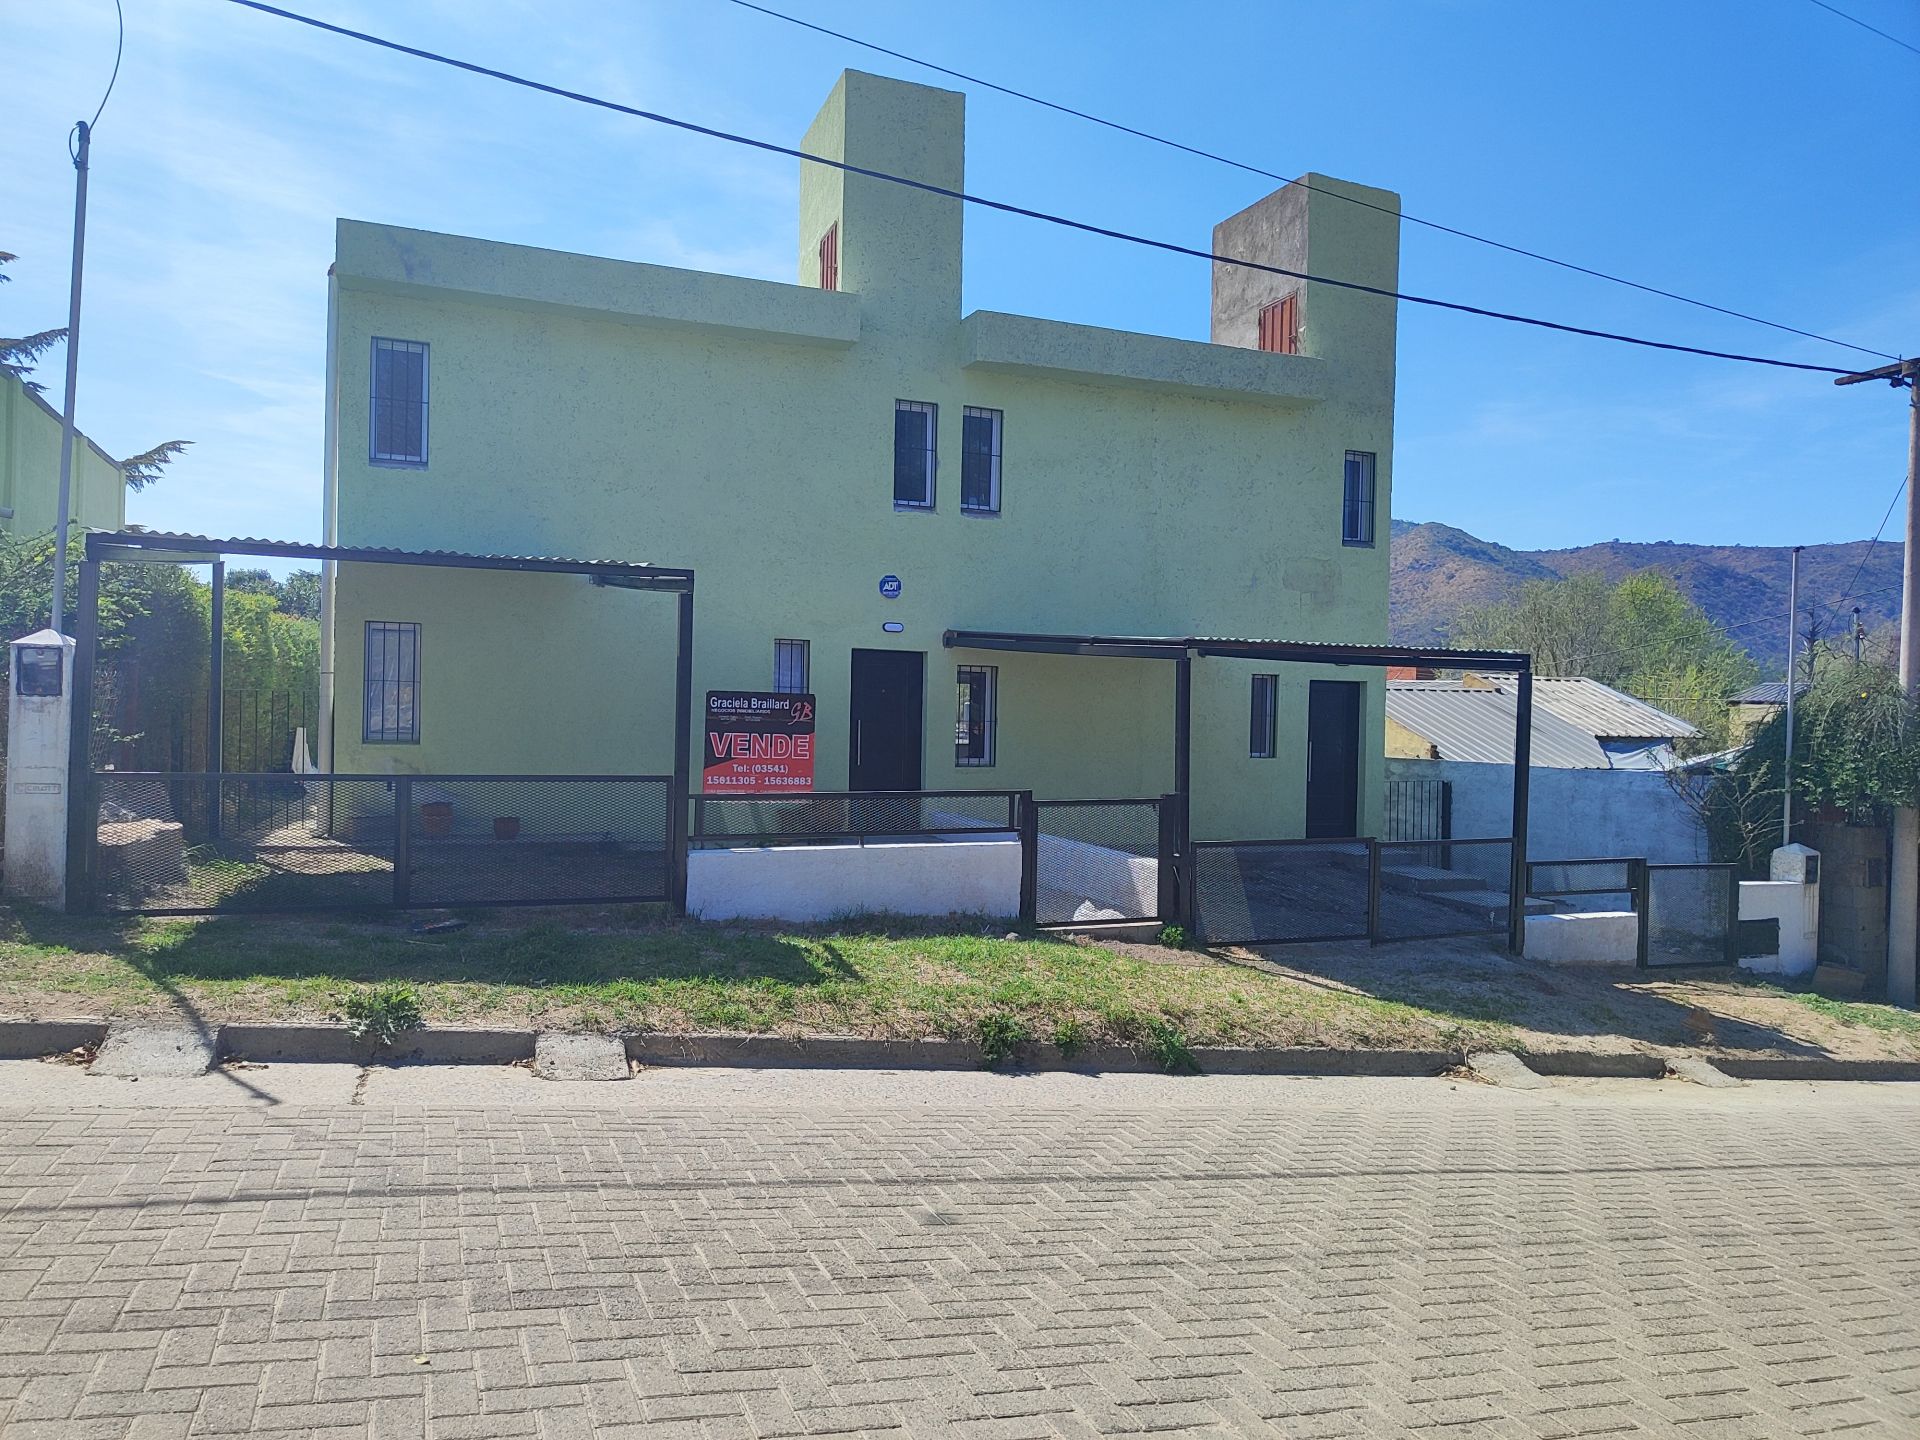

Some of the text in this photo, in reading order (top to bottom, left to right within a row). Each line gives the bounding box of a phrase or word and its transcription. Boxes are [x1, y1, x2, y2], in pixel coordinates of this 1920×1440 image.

[883, 582, 898, 590] ADT
[710, 697, 789, 709] Graciela Braillard
[710, 732, 810, 759] VENDE
[732, 764, 789, 774] Tel: (03541)
